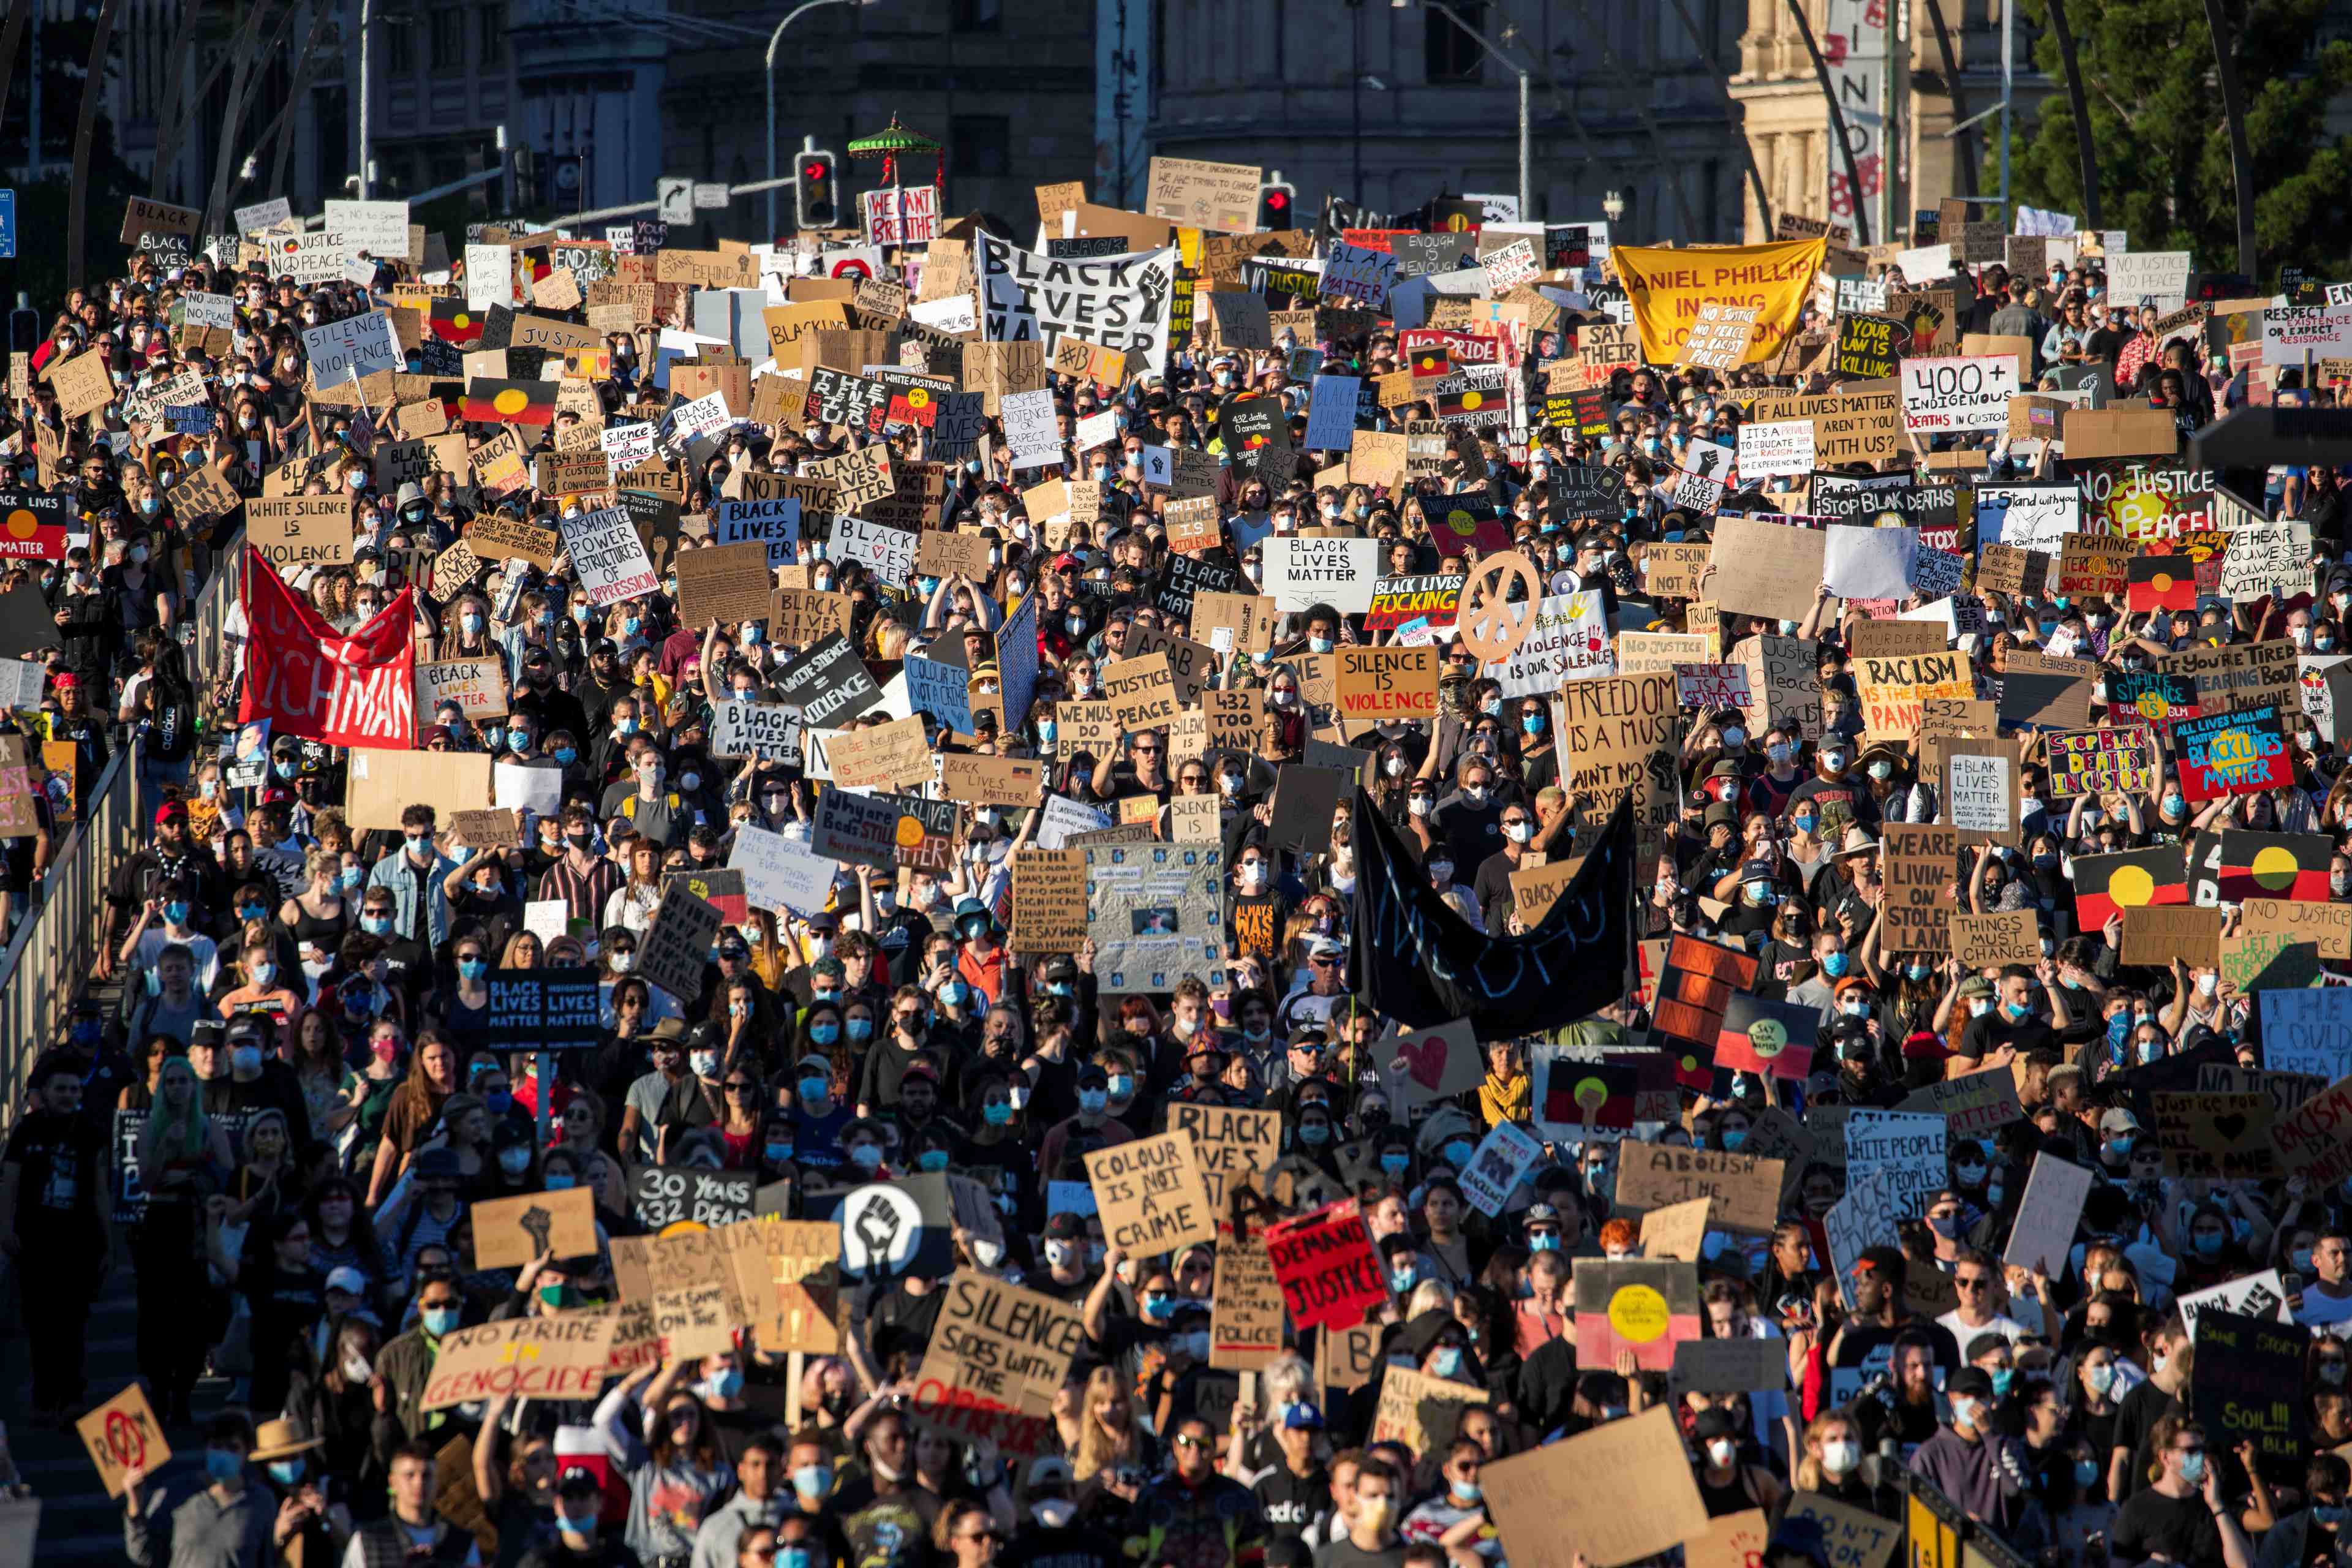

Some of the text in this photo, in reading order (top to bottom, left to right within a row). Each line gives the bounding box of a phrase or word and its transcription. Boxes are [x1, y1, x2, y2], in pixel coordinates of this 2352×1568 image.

[1193, 163, 1206, 173] THE
[1158, 173, 1170, 183] WE
[1219, 179, 1230, 187] TO
[870, 194, 894, 215] WE
[1157, 186, 1253, 205] THE WORLD!
[985, 239, 1134, 287] BLACK
[1333, 248, 1396, 271] BLAK
[1483, 240, 1529, 267] BREAK THE
[1329, 262, 1383, 283] LIVES
[1488, 252, 1531, 277] SYSTEM
[1490, 271, 1520, 287] BUILD
[1519, 269, 1540, 282] ONE
[1322, 274, 1384, 300] MATTER
[187, 292, 233, 305] NO JUSTICE
[987, 281, 1129, 327] LIVES
[187, 307, 232, 322] NO PEACE
[1702, 307, 1755, 323] NO JUSTICE
[2155, 309, 2200, 334] MURDER
[2263, 307, 2326, 321] RESPECT
[2287, 315, 2350, 327] EXISTENCE
[309, 315, 387, 348] SILENCE
[1589, 325, 1626, 343] SAY
[1694, 325, 1746, 337] NO PEACE
[1853, 320, 1890, 340] YOUR
[2269, 326, 2331, 336] OR EXPECT
[2280, 333, 2340, 344] RESISTANCE
[1580, 344, 1635, 361] THEIR
[1686, 338, 1743, 352] NO RACIST
[1842, 337, 1887, 355] LAW IS
[314, 341, 393, 374] VIOLENCE
[1060, 343, 1124, 377] #BLM
[59, 360, 92, 385] BLACK
[62, 375, 97, 395] LIVES
[1436, 374, 1506, 393] SAME STORY
[68, 386, 105, 412] MATTER
[1758, 394, 1896, 419] IF ALL LIVES MATTER
[1909, 390, 2011, 410] INDIGENOUS
[1869, 415, 1894, 428] YOU
[1907, 413, 2008, 428] DEATHS IN CUSTOD
[1815, 436, 1894, 456] WITH US?
[577, 454, 606, 463] DEATHS
[565, 466, 607, 475] CUSTODY
[563, 479, 609, 490] CONVICTIONS
[249, 502, 347, 516] WHITE SILENCE
[1820, 489, 1954, 514] STOP BLAK DEATHS
[285, 521, 300, 534] IS
[564, 507, 628, 538] DISMANTLE
[571, 528, 631, 551] POWER
[937, 534, 974, 549] BLACK
[1291, 540, 1348, 551] BLACK
[256, 544, 342, 564] VIOLENCE
[578, 542, 641, 573] STRUCTURES
[941, 548, 970, 560] LIVES
[1291, 555, 1350, 567] LIVES
[603, 567, 619, 582] OF
[927, 559, 977, 575] MATTER
[1289, 570, 1355, 581] MATTER
[589, 572, 657, 606] OPPRESSION
[1375, 575, 1461, 594] BLACK LIVES
[1371, 590, 1457, 613] FUCKING
[1345, 654, 1426, 673] SILENCE
[1868, 657, 1956, 684] RACISM
[1107, 669, 1171, 697] JUSTICE
[1377, 674, 1393, 689] IS
[1216, 693, 1250, 709] 432
[1344, 692, 1434, 710] VIOLENCE
[1566, 675, 1676, 722] FREEDOM
[729, 706, 797, 729] BLACK
[1117, 699, 1173, 724] PEACE
[1213, 714, 1253, 726] TOO
[162, 705, 175, 751] adidas
[736, 728, 785, 741] LIVES
[1212, 729, 1265, 747] MANY
[1570, 715, 1678, 752] IS A MUST
[726, 742, 800, 759] MATTER
[2049, 728, 2144, 753] STOP BLAK
[2070, 750, 2139, 773] DEATHS
[2053, 768, 2149, 793] IN CUSTODY
[1886, 835, 1915, 856] WE
[1910, 889, 1936, 905] ON
[1956, 916, 2022, 932] THINGS
[1971, 932, 2021, 944] MUST
[1094, 1140, 1180, 1180] COLOUR
[639, 1169, 750, 1202] 30 YEARS
[1108, 1167, 1180, 1201] IS NOT
[1142, 1196, 1158, 1215] A
[1115, 1204, 1196, 1246] CRIME
[1272, 1223, 1364, 1268] DEMAND
[1286, 1258, 1381, 1314] JUSTICE
[949, 1280, 1084, 1354] SILENCE
[448, 1316, 608, 1352] NO PRIDE
[499, 1343, 540, 1362] IN
[940, 1323, 1056, 1380] SIDES WITH
[429, 1365, 606, 1403] GENOCIDE
[963, 1366, 1004, 1394] THE
